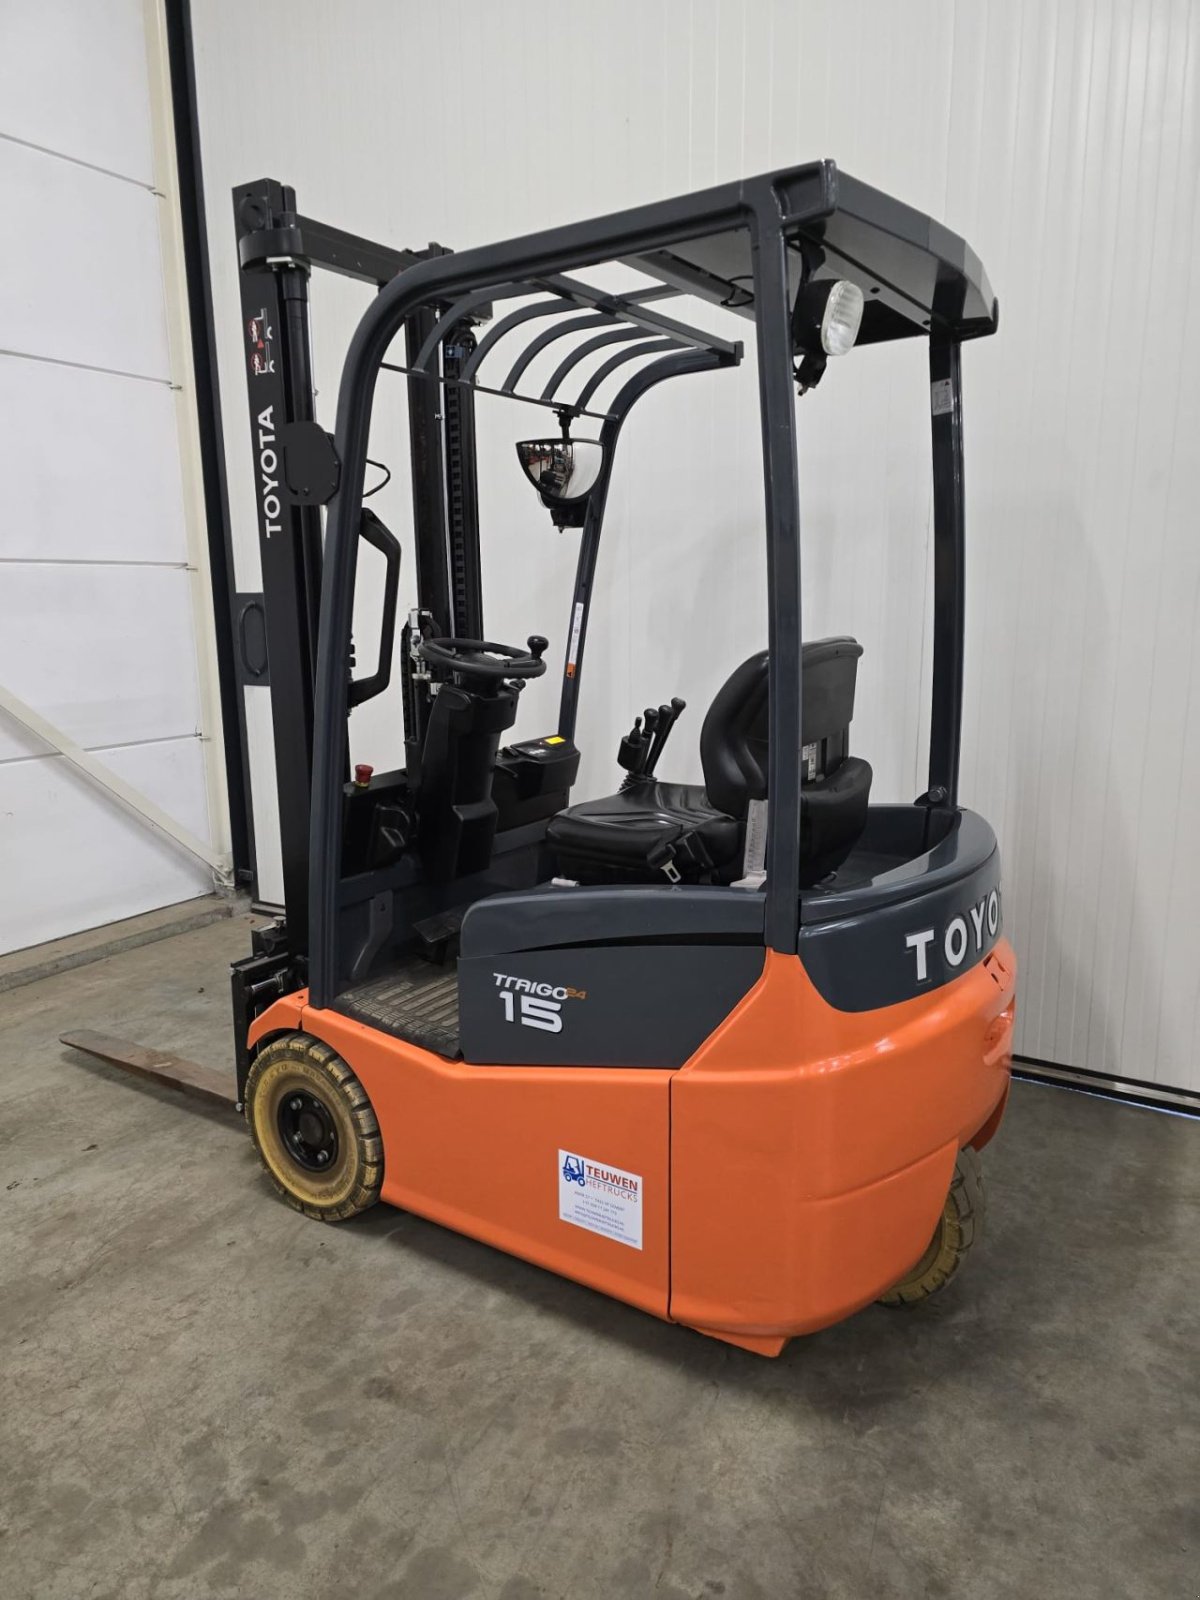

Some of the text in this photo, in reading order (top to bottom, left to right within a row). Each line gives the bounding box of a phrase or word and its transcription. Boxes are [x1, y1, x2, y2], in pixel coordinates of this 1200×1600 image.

[257, 404, 282, 539] TOYOTA
[906, 889, 1000, 981] TOYO
[493, 972, 568, 1000] TRAIGO
[499, 990, 563, 1033] 15
[586, 1164, 638, 1192] TEUWEN
[586, 1178, 638, 1203] HEFTRUCKS
